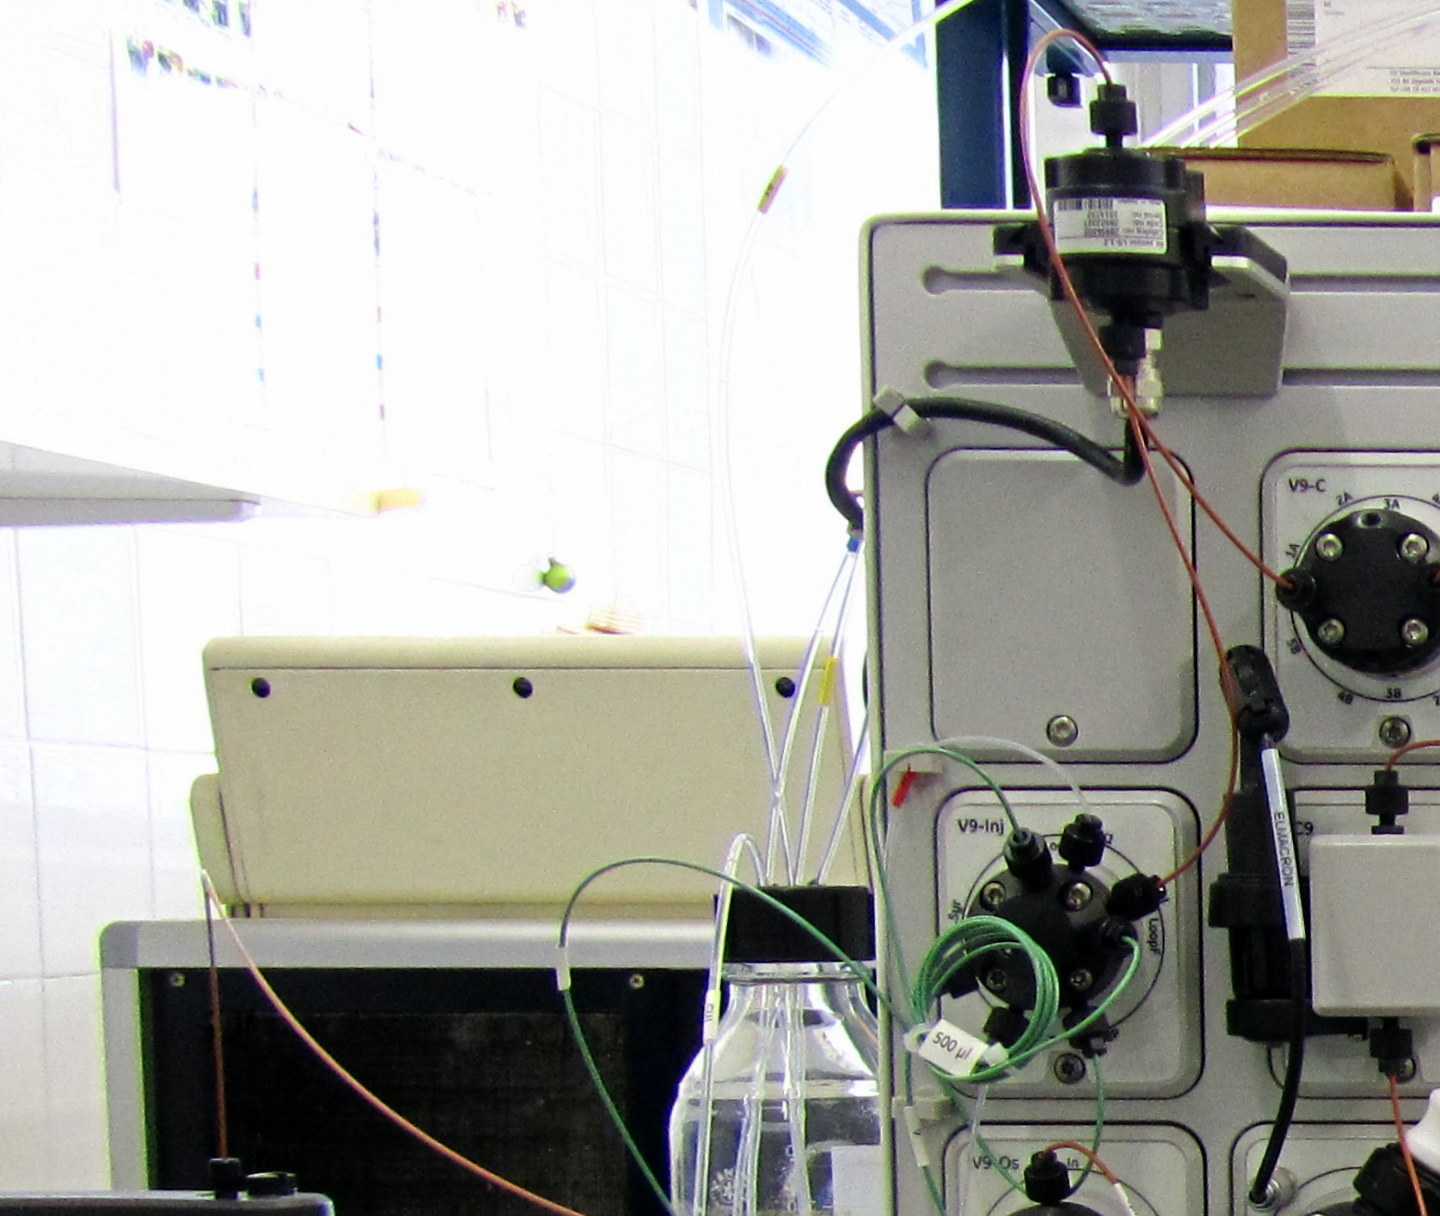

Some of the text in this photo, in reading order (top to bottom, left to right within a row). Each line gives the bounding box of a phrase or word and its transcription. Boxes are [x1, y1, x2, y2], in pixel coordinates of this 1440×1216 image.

[1288, 478, 1327, 493] V9-C
[957, 818, 1005, 834] V9-Inj
[932, 1031, 958, 1052] 500
[972, 1157, 1020, 1170] V9Os
